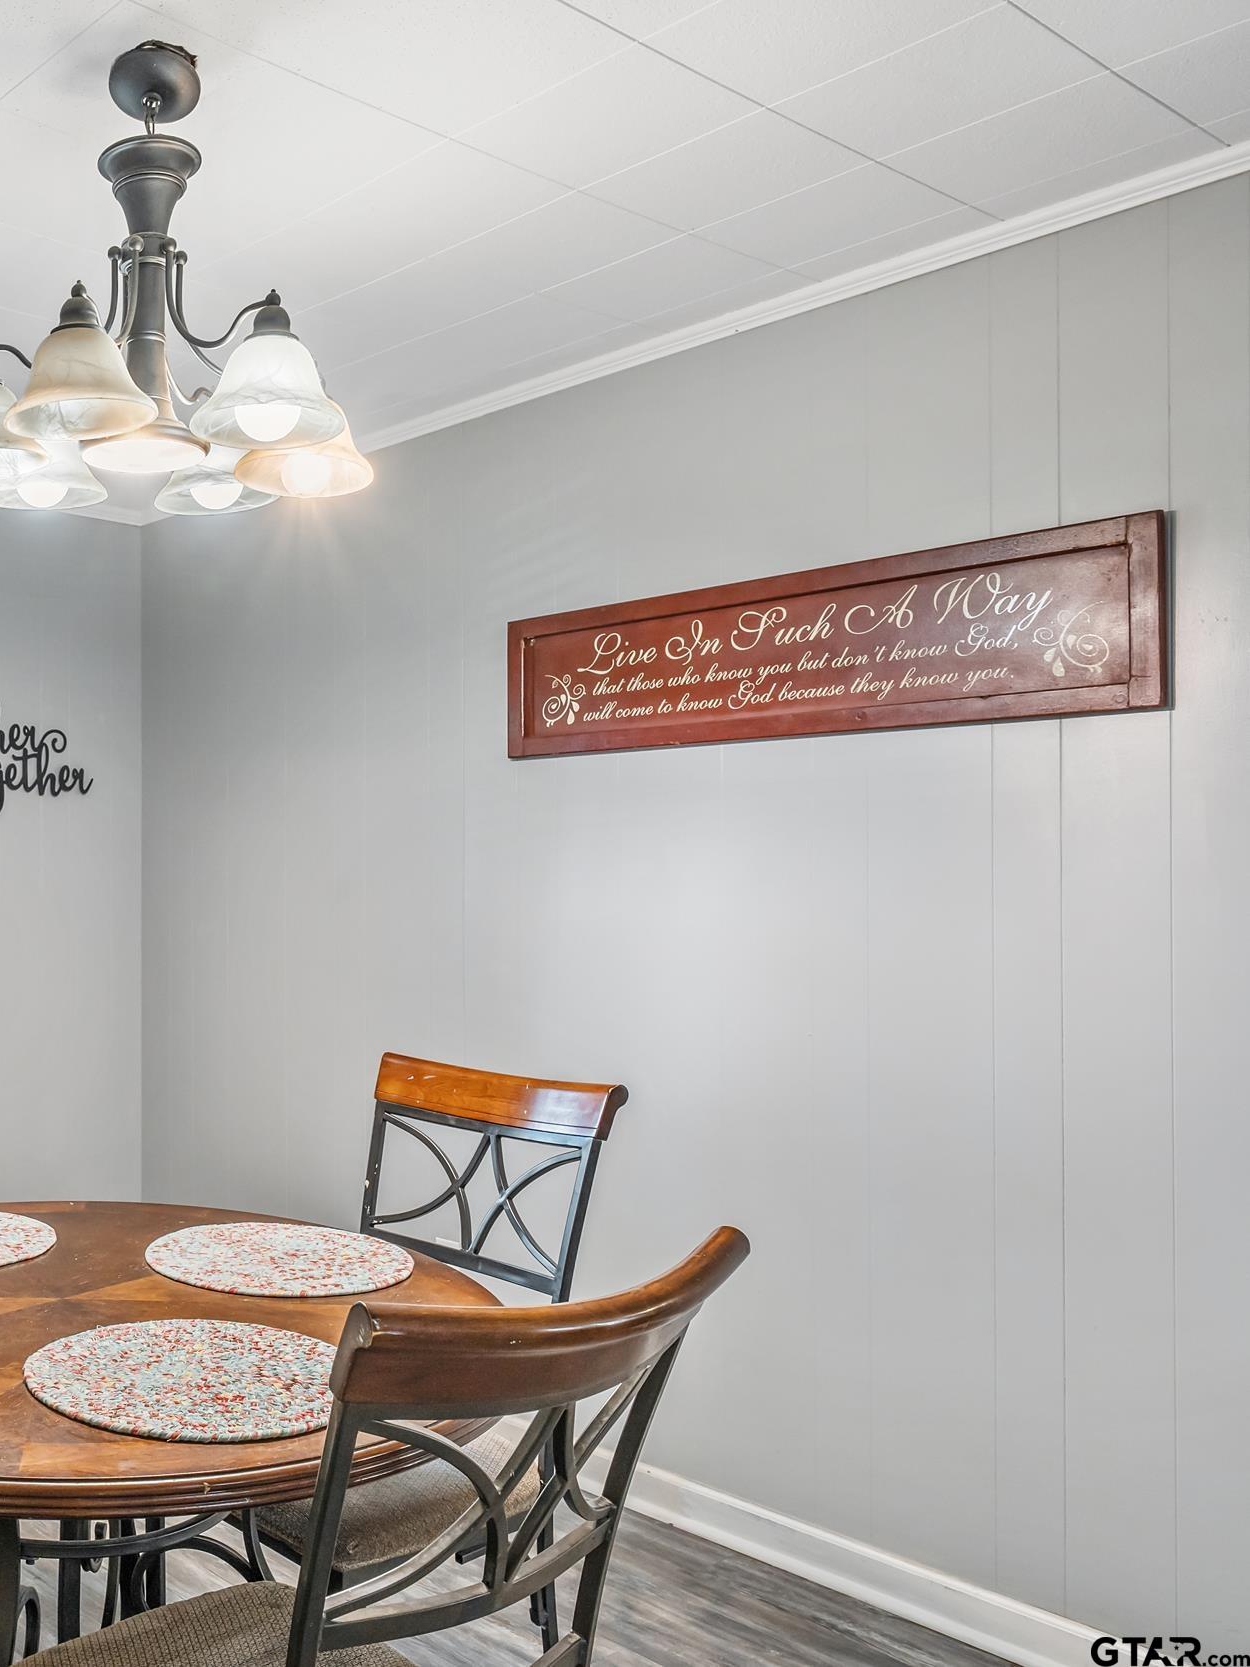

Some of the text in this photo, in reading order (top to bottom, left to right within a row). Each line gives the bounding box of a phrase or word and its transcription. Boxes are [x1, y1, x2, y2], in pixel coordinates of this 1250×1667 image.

[577, 572, 1054, 675] Live In Such A Way
[592, 622, 1019, 697] that those who know you but don't know God,
[582, 665, 1015, 722] will come to know God because they know you.
